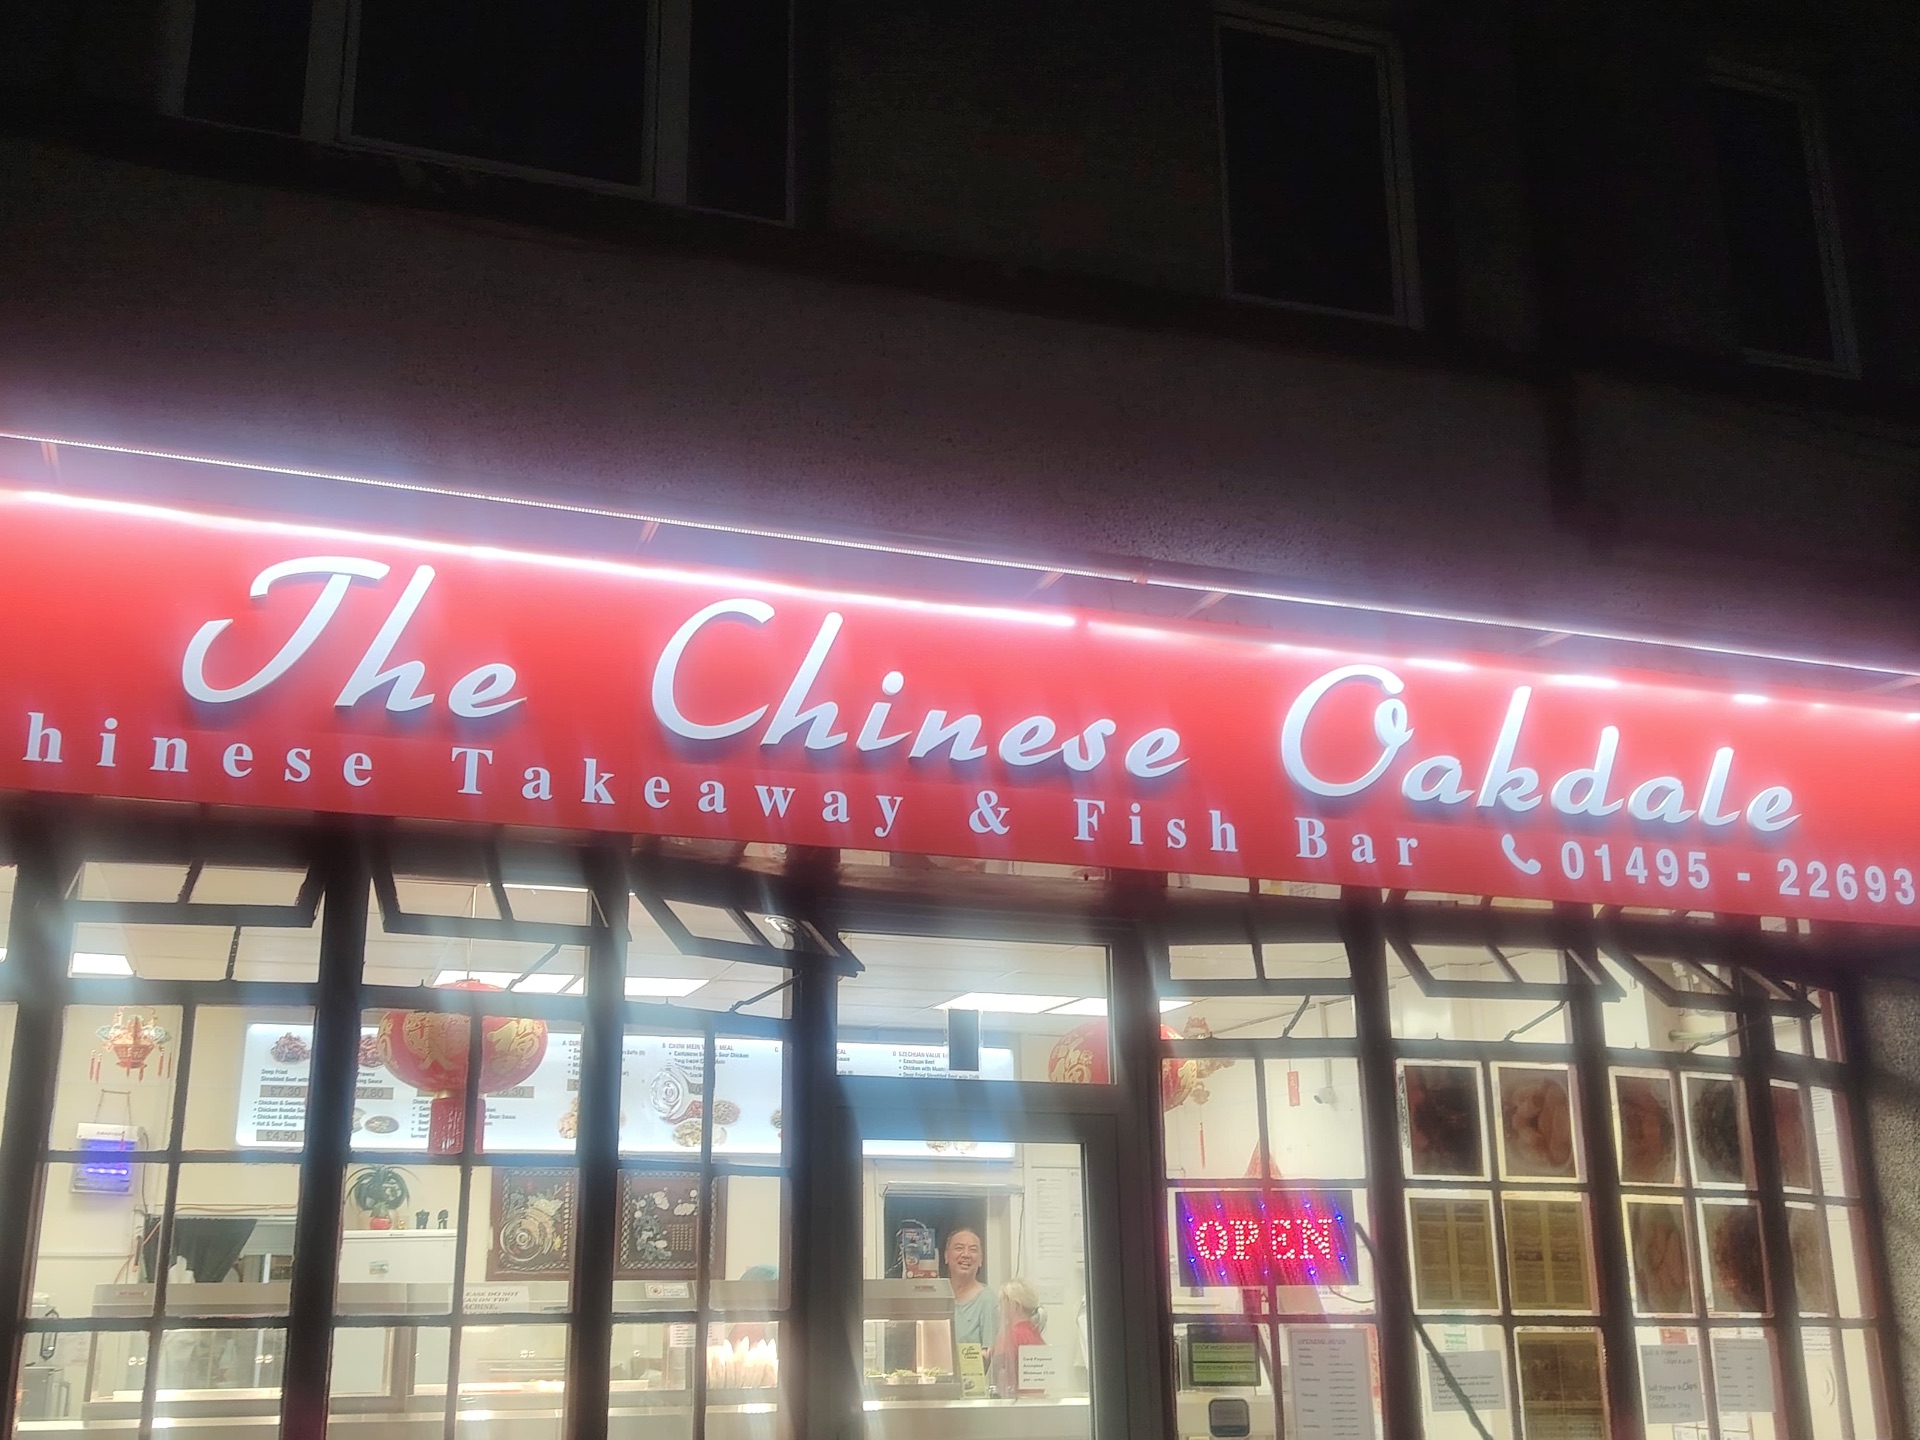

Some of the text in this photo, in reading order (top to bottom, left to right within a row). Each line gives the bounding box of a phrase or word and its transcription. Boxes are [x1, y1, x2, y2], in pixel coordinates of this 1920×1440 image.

[182, 556, 1801, 832] The Chinese Oakdale
[450, 747, 903, 838] Takeaway
[968, 789, 1010, 836] &
[1073, 798, 1239, 854] Fish
[1295, 816, 1419, 867] Bar
[1561, 840, 1711, 890] 01495
[1776, 858, 1916, 906] 22693
[1195, 1217, 1333, 1261] OPEN
